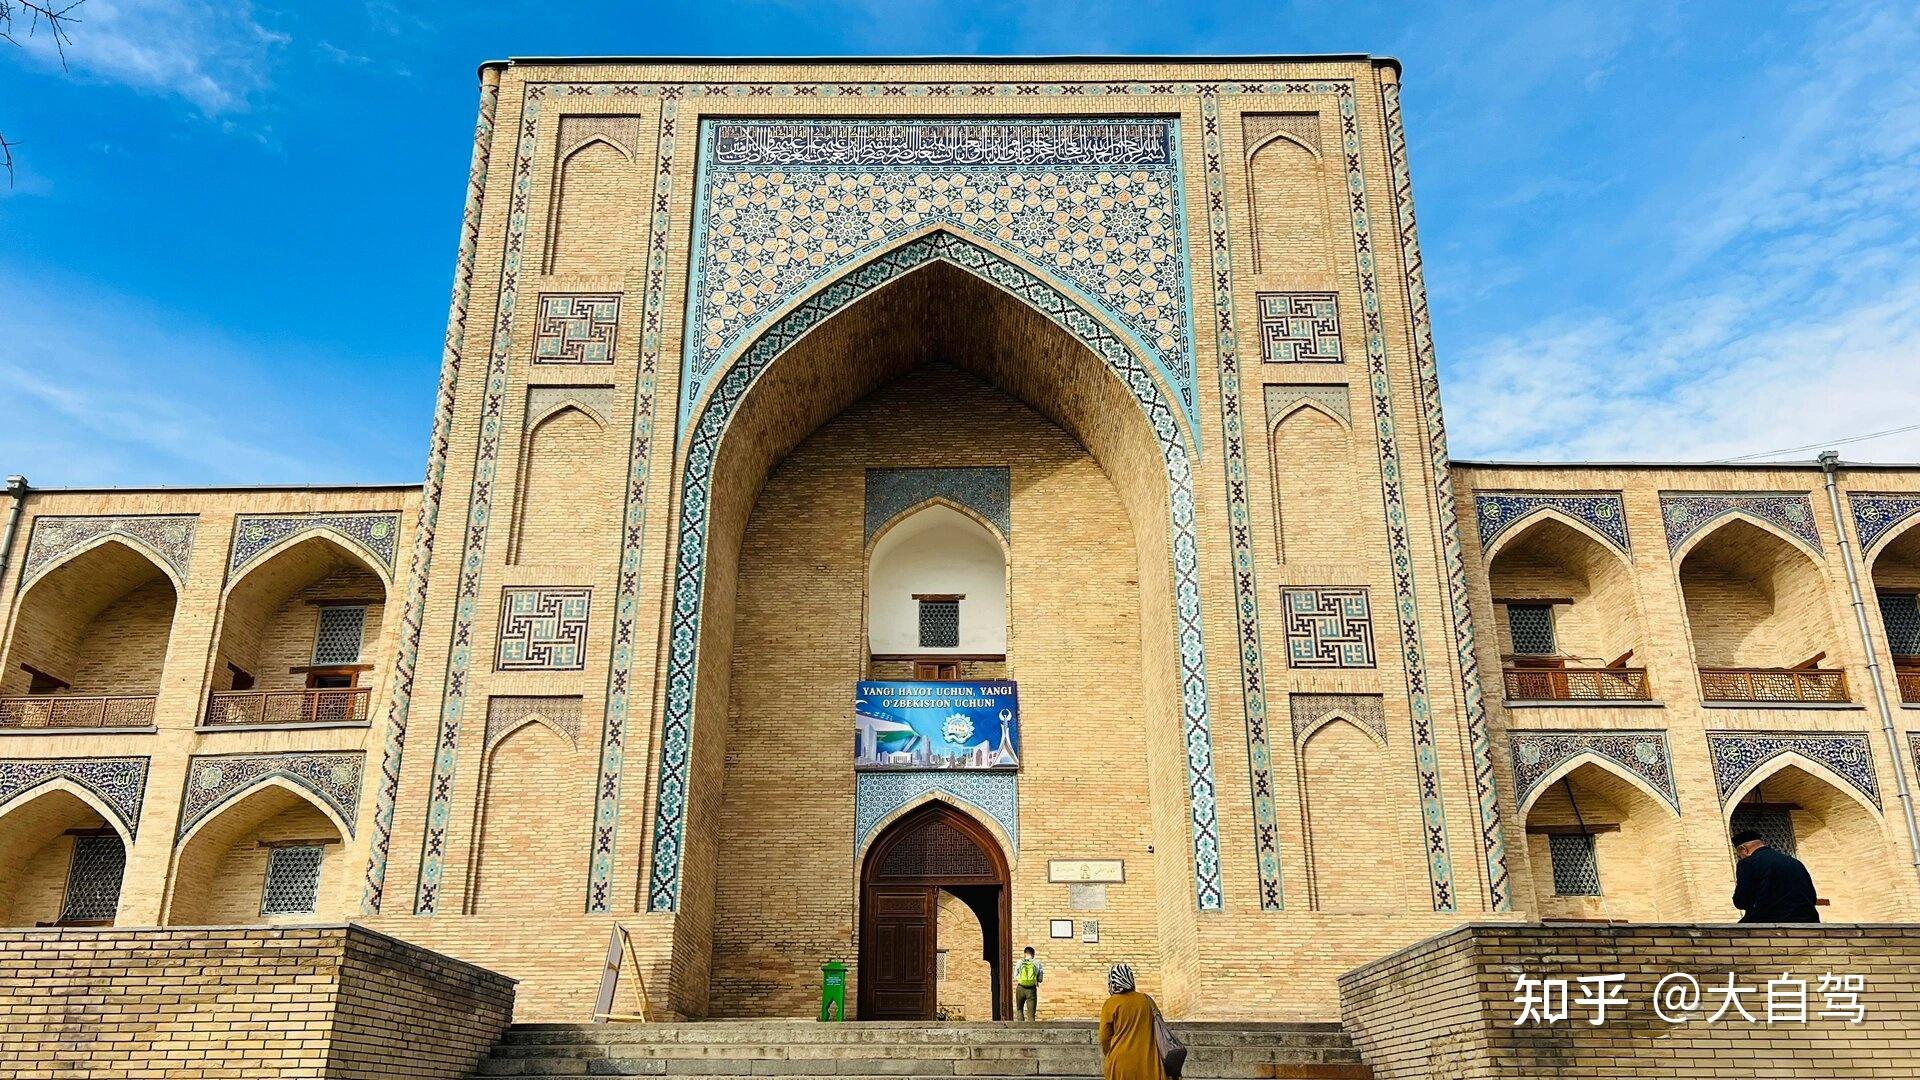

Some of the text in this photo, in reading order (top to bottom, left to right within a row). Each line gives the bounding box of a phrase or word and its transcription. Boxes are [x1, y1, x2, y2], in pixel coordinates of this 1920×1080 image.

[863, 686, 1012, 697] YANGI HAYOT UCHUN, YANGI
[954, 698, 995, 708] UCHUN!
